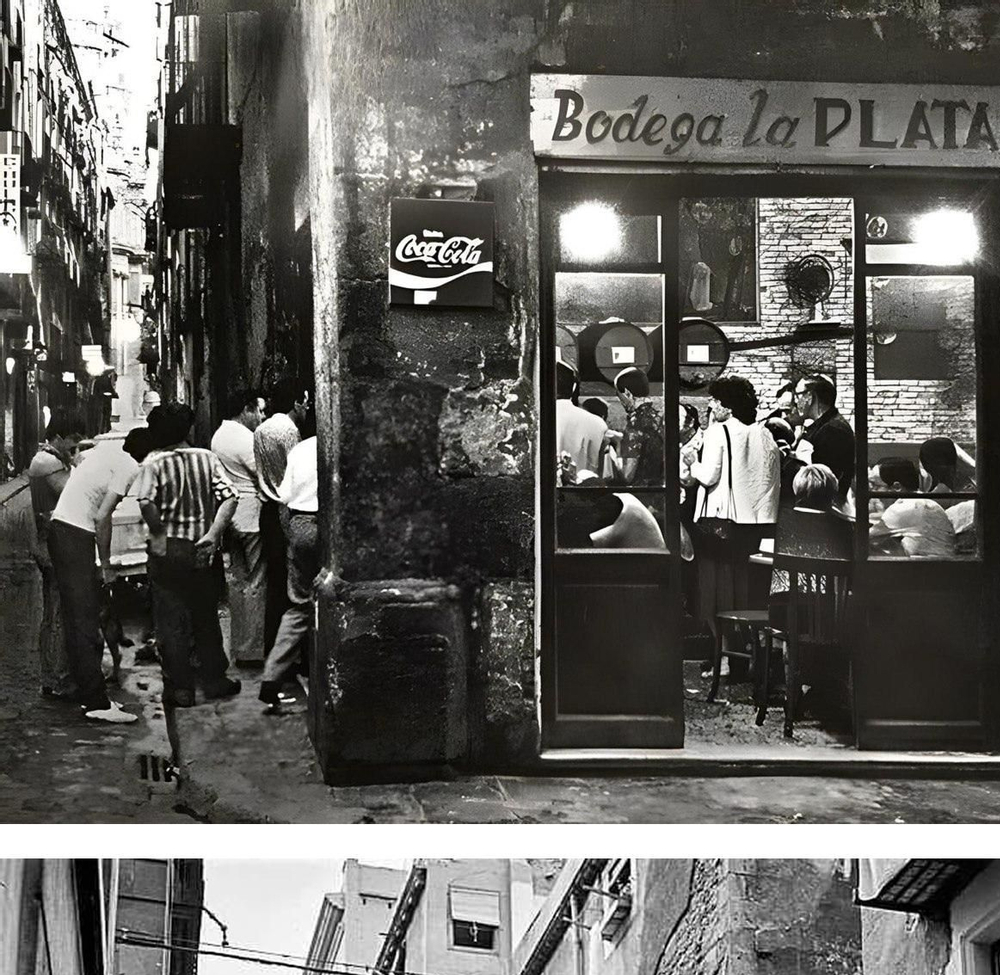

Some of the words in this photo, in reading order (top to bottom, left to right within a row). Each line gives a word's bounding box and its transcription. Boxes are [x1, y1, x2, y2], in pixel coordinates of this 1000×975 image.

[551, 89, 725, 155] Bodega
[742, 88, 799, 150] la
[813, 97, 1000, 152] PLATA
